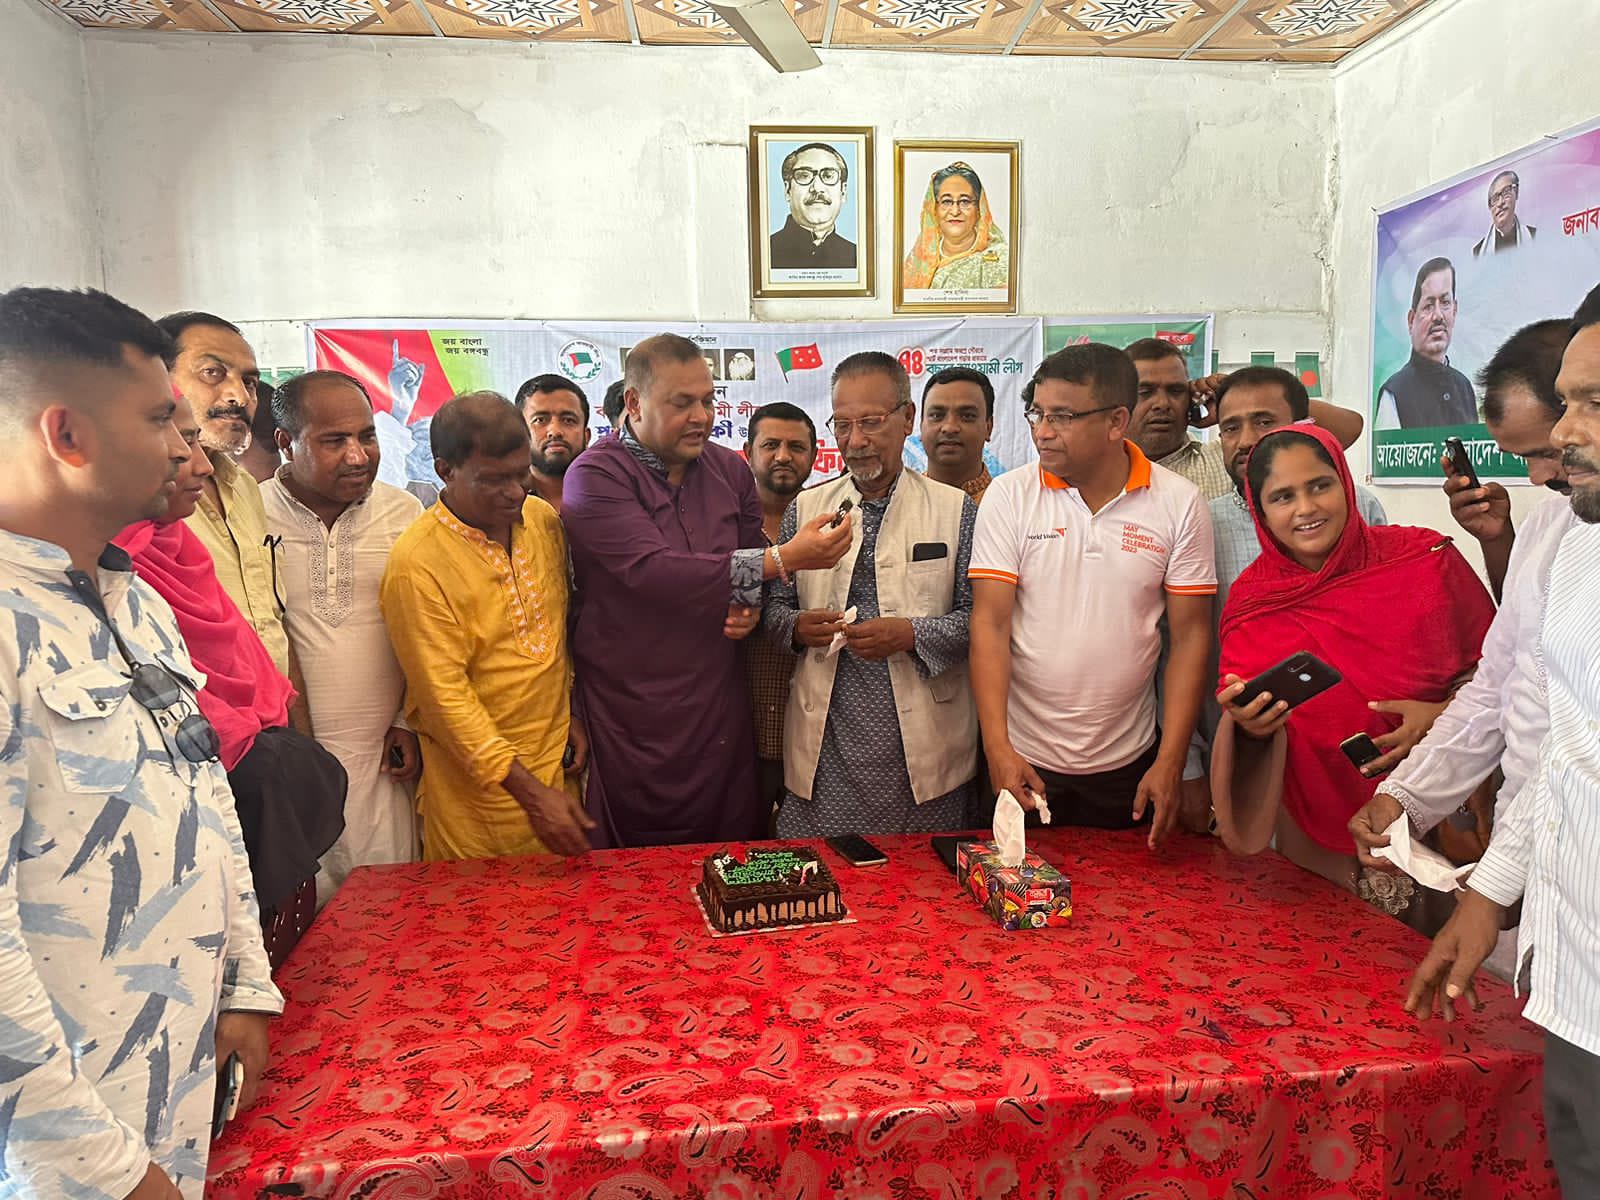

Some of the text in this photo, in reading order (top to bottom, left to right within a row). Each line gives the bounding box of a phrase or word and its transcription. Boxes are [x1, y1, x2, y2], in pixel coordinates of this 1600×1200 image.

[1562, 206, 1600, 236] জনাব
[458, 337, 482, 346] বাংলা
[1002, 357, 1024, 374] লীগ
[1123, 524, 1139, 533] MAY
[1122, 531, 1154, 544] MOMENT
[1121, 538, 1166, 554] CELEBRATION
